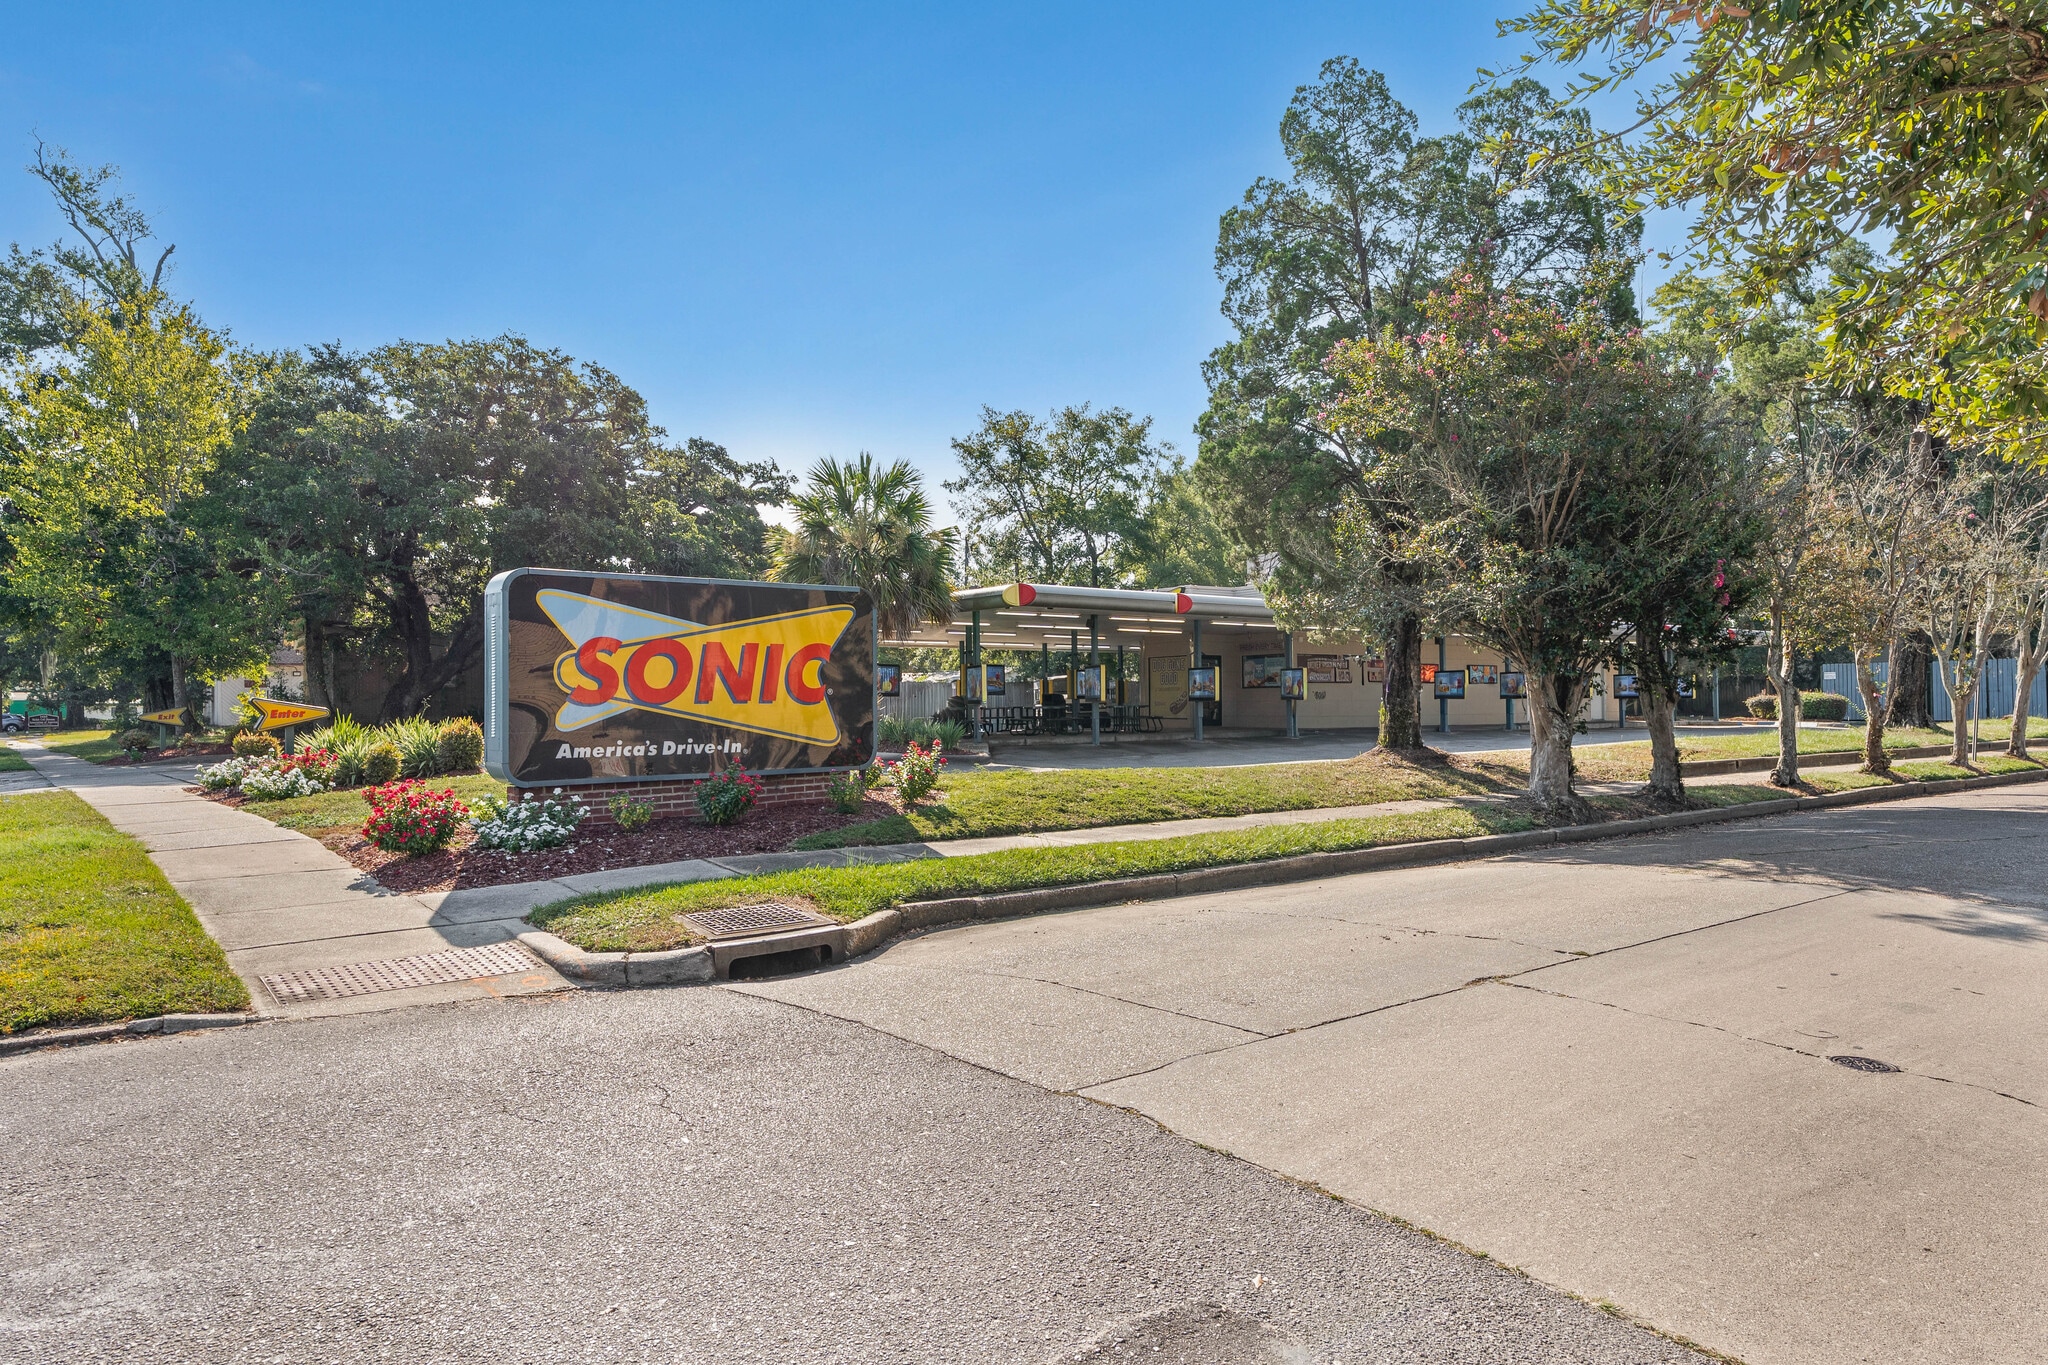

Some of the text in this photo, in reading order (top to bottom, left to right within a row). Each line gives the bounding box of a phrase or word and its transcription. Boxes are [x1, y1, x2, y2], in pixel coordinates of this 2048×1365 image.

[566, 636, 832, 706] SONIC
[1160, 672, 1178, 685] GOOD
[157, 713, 175, 721] Exit
[270, 709, 306, 719] Enter
[556, 740, 658, 759] America's
